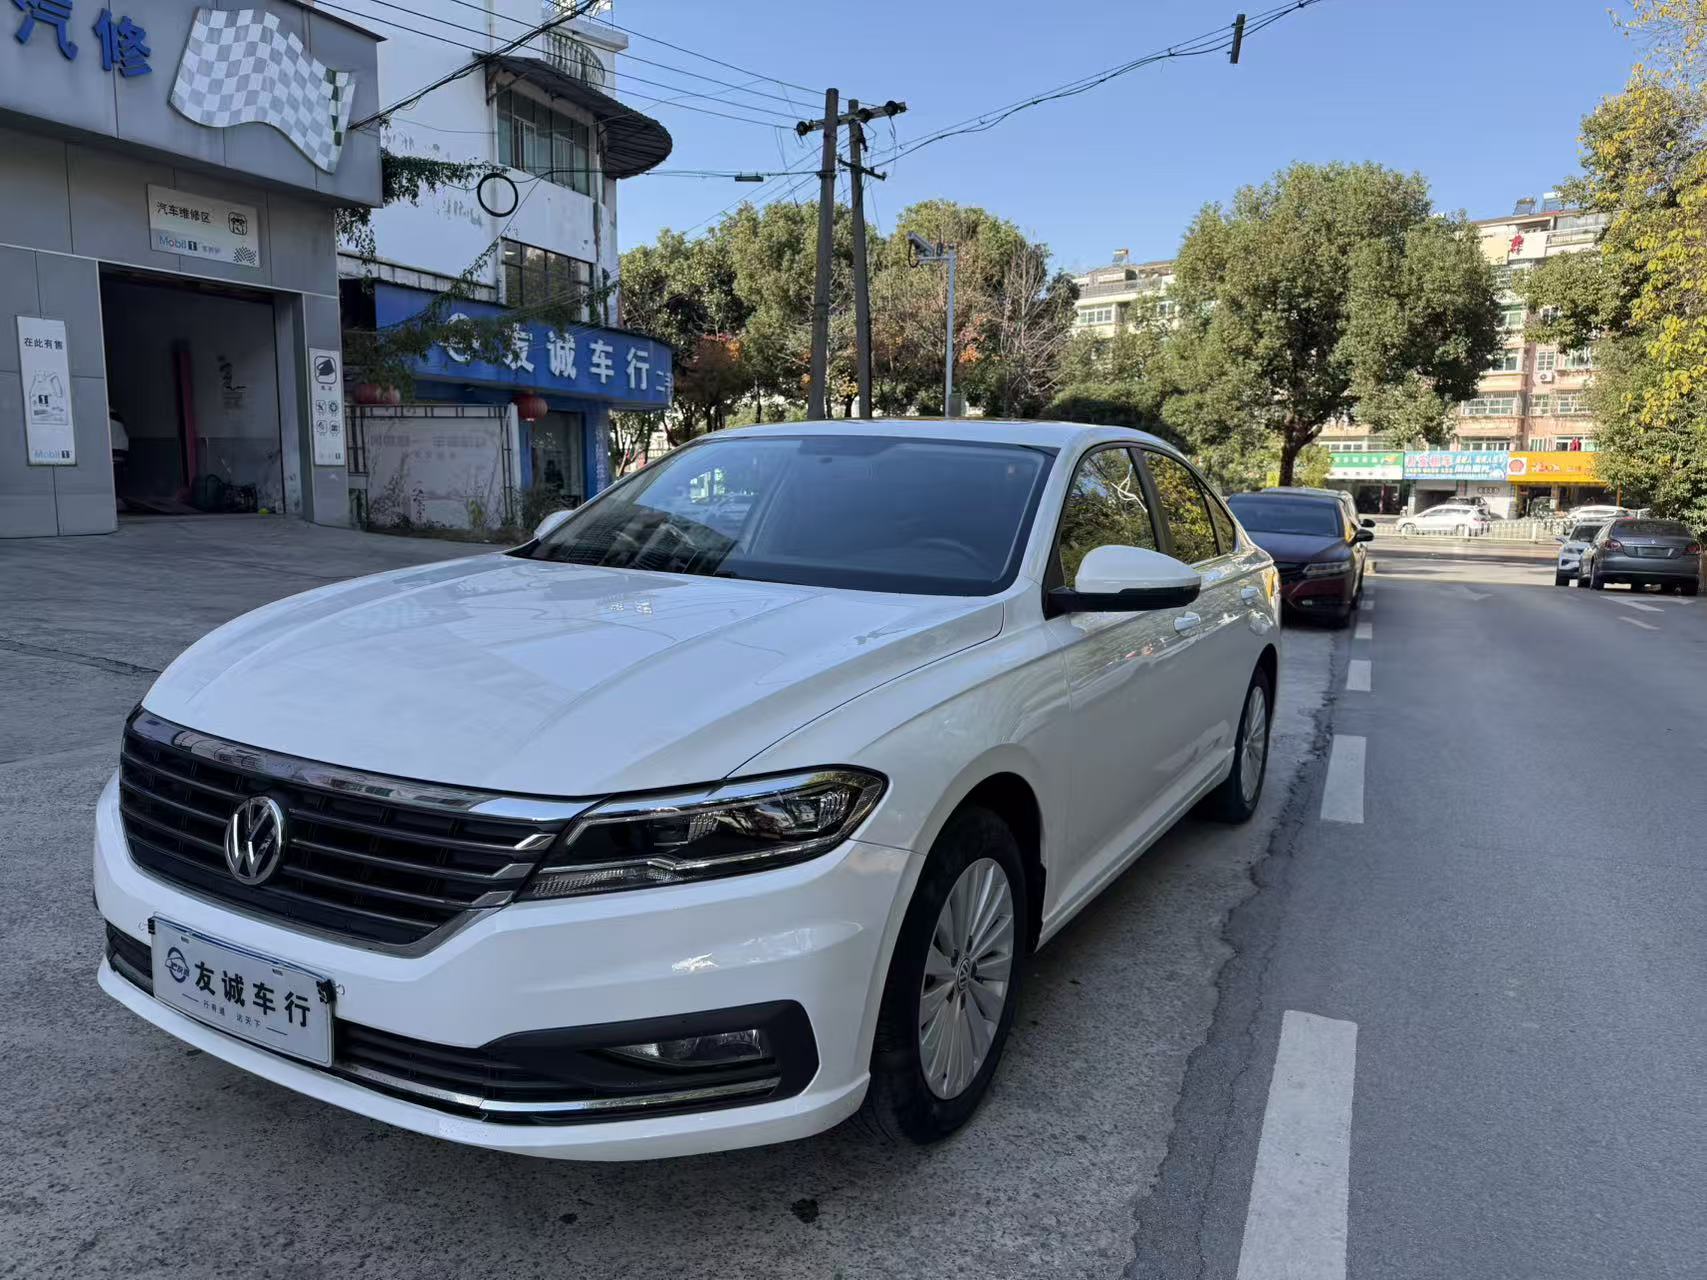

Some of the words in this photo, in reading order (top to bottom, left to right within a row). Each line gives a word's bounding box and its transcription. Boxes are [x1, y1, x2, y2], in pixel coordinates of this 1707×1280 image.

[157, 201, 211, 224] 汽车维修区
[160, 235, 187, 249] Mobil
[24, 337, 63, 350] 在此有售
[34, 450, 60, 459] Mobil
[194, 961, 310, 1028] 友诚车行
